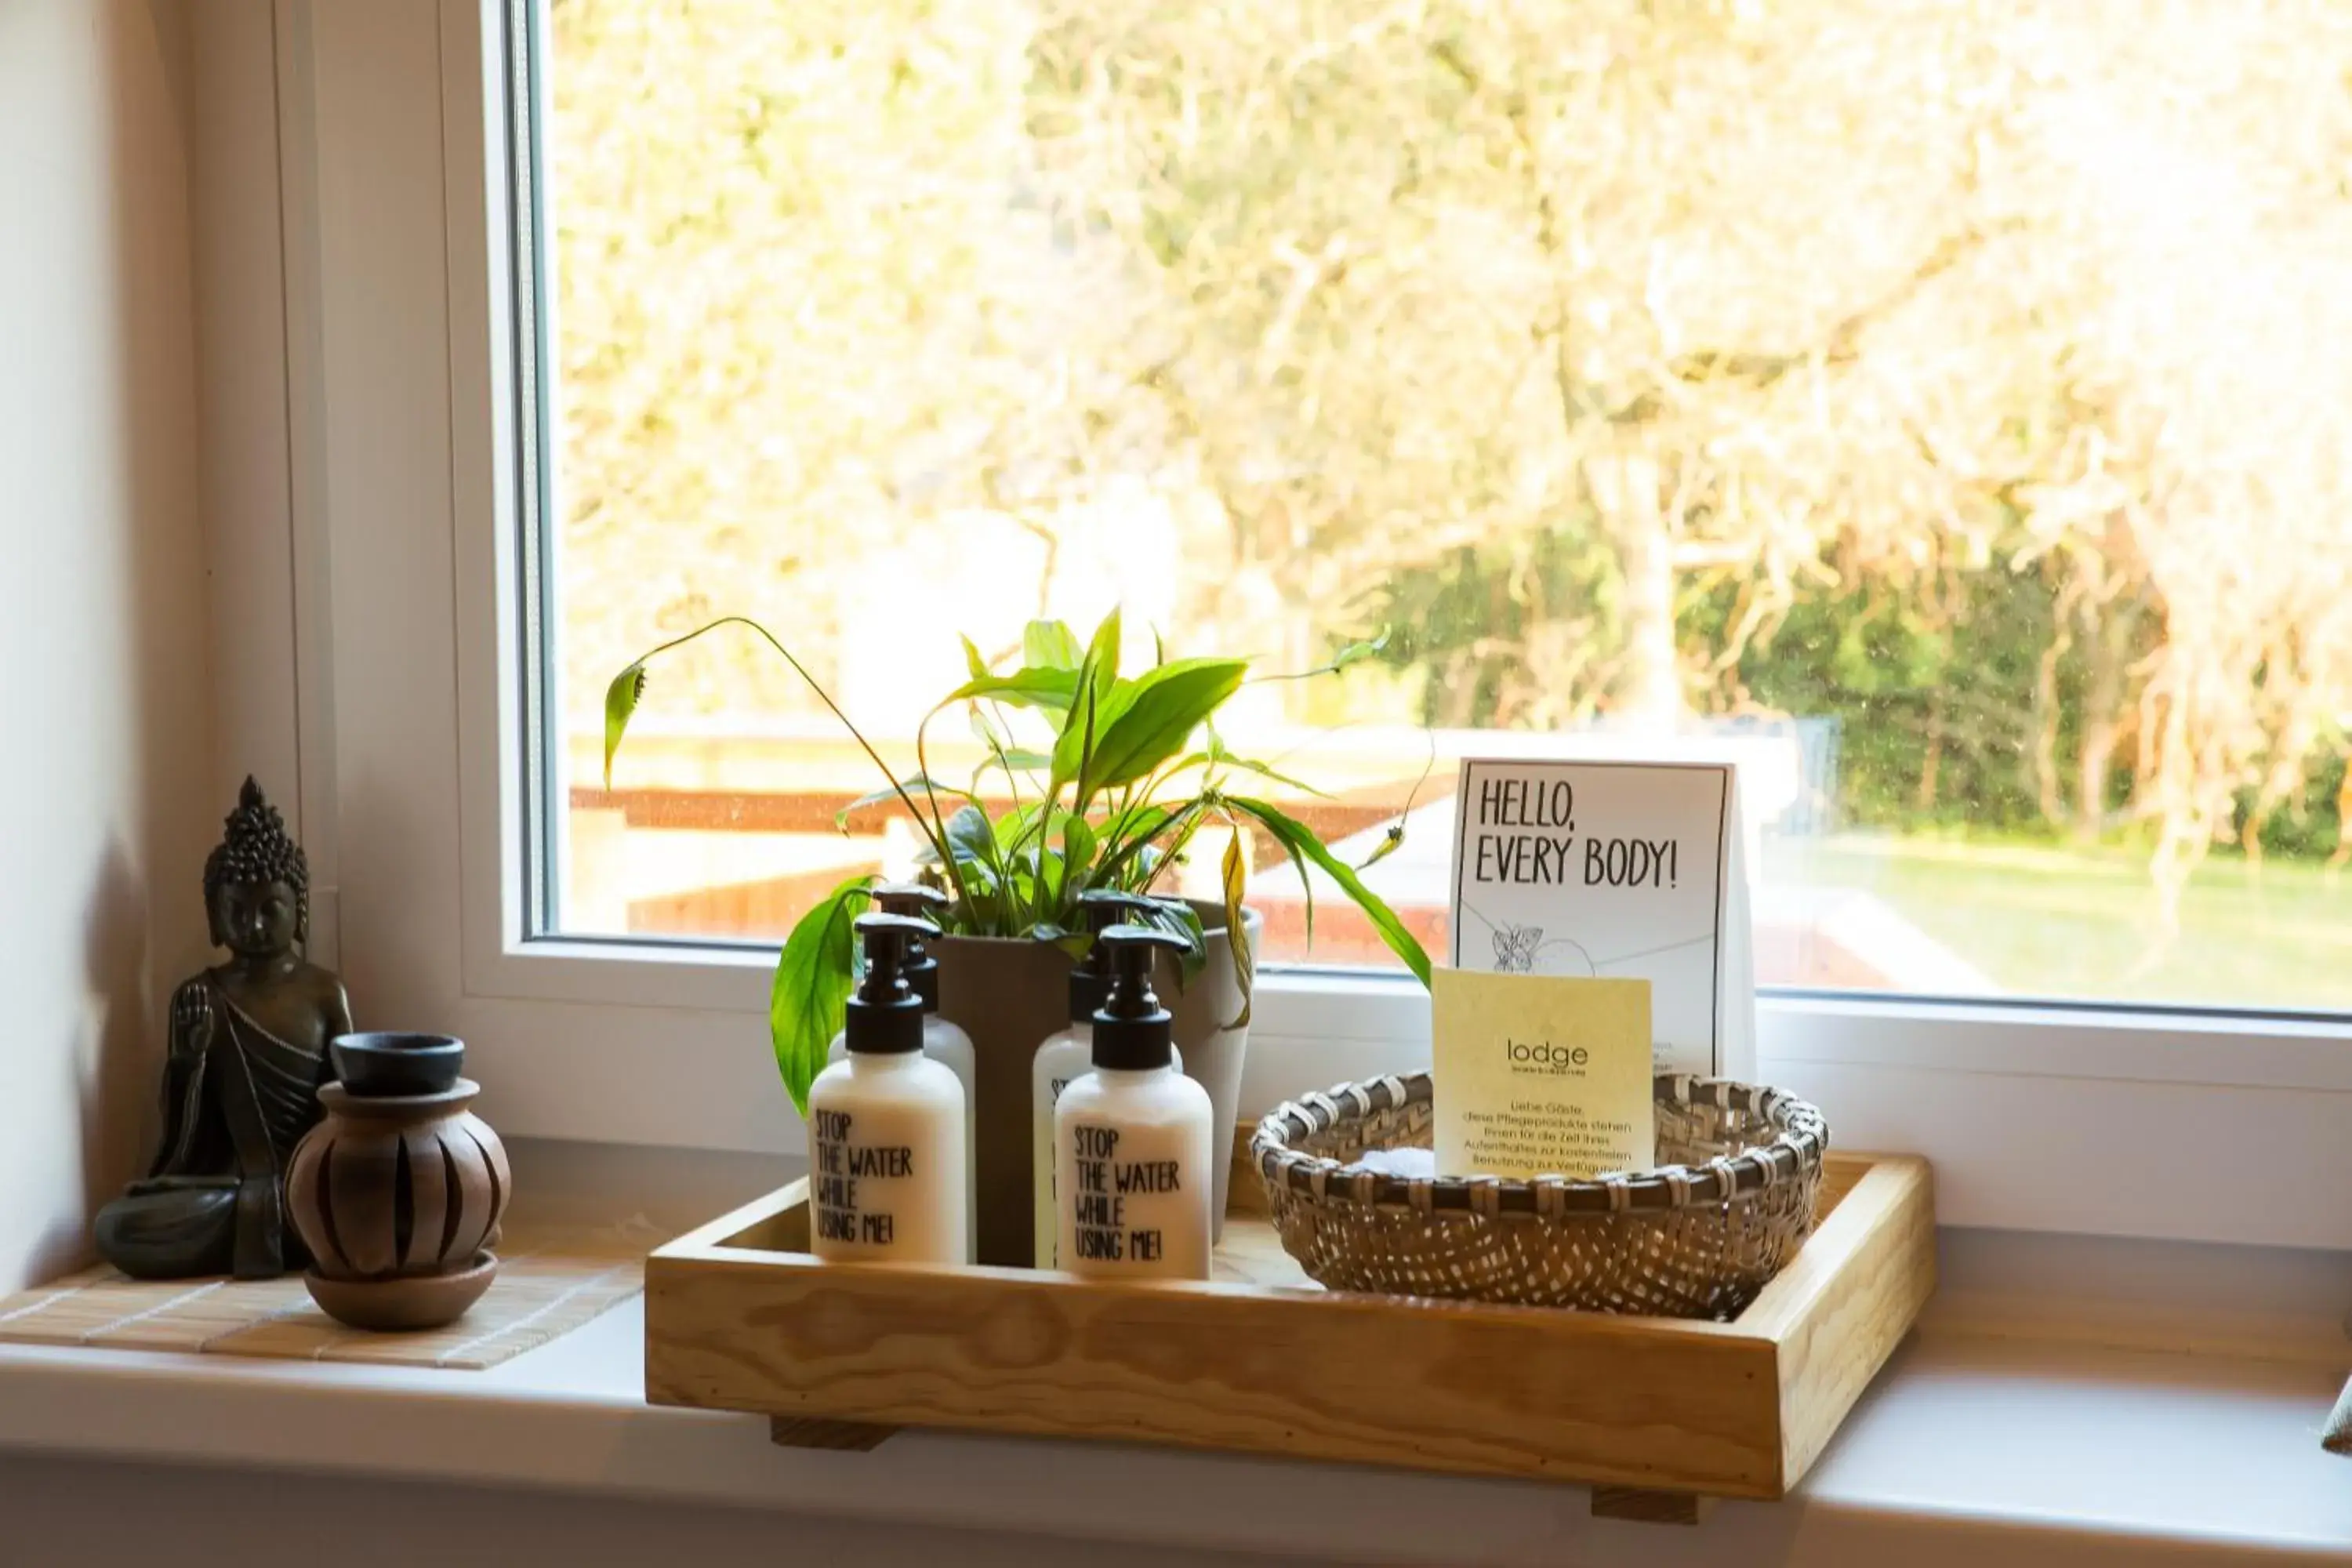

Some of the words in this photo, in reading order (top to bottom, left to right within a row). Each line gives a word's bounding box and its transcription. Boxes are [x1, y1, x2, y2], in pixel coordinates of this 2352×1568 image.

[1480, 779, 1574, 832] HELLO,
[1476, 834, 1572, 884] EVERY
[1584, 837, 1677, 889] BODY!
[1508, 1037, 1588, 1069] lodge
[816, 1108, 852, 1142] STOP
[1074, 1124, 1120, 1159] STOP
[1519, 1128, 1534, 1140] für
[1537, 1130, 1556, 1142] die
[1591, 1120, 1632, 1134] stehen
[817, 1140, 843, 1175] THE
[848, 1145, 913, 1178] WATER
[1076, 1159, 1107, 1192] THE
[1114, 1160, 1181, 1194] WATER
[817, 1176, 858, 1210] WHILE
[1075, 1193, 1126, 1227] WHILE
[818, 1207, 856, 1243] USING
[863, 1213, 894, 1245] ME!
[1076, 1226, 1123, 1261] USING
[1130, 1229, 1163, 1262] ME!
